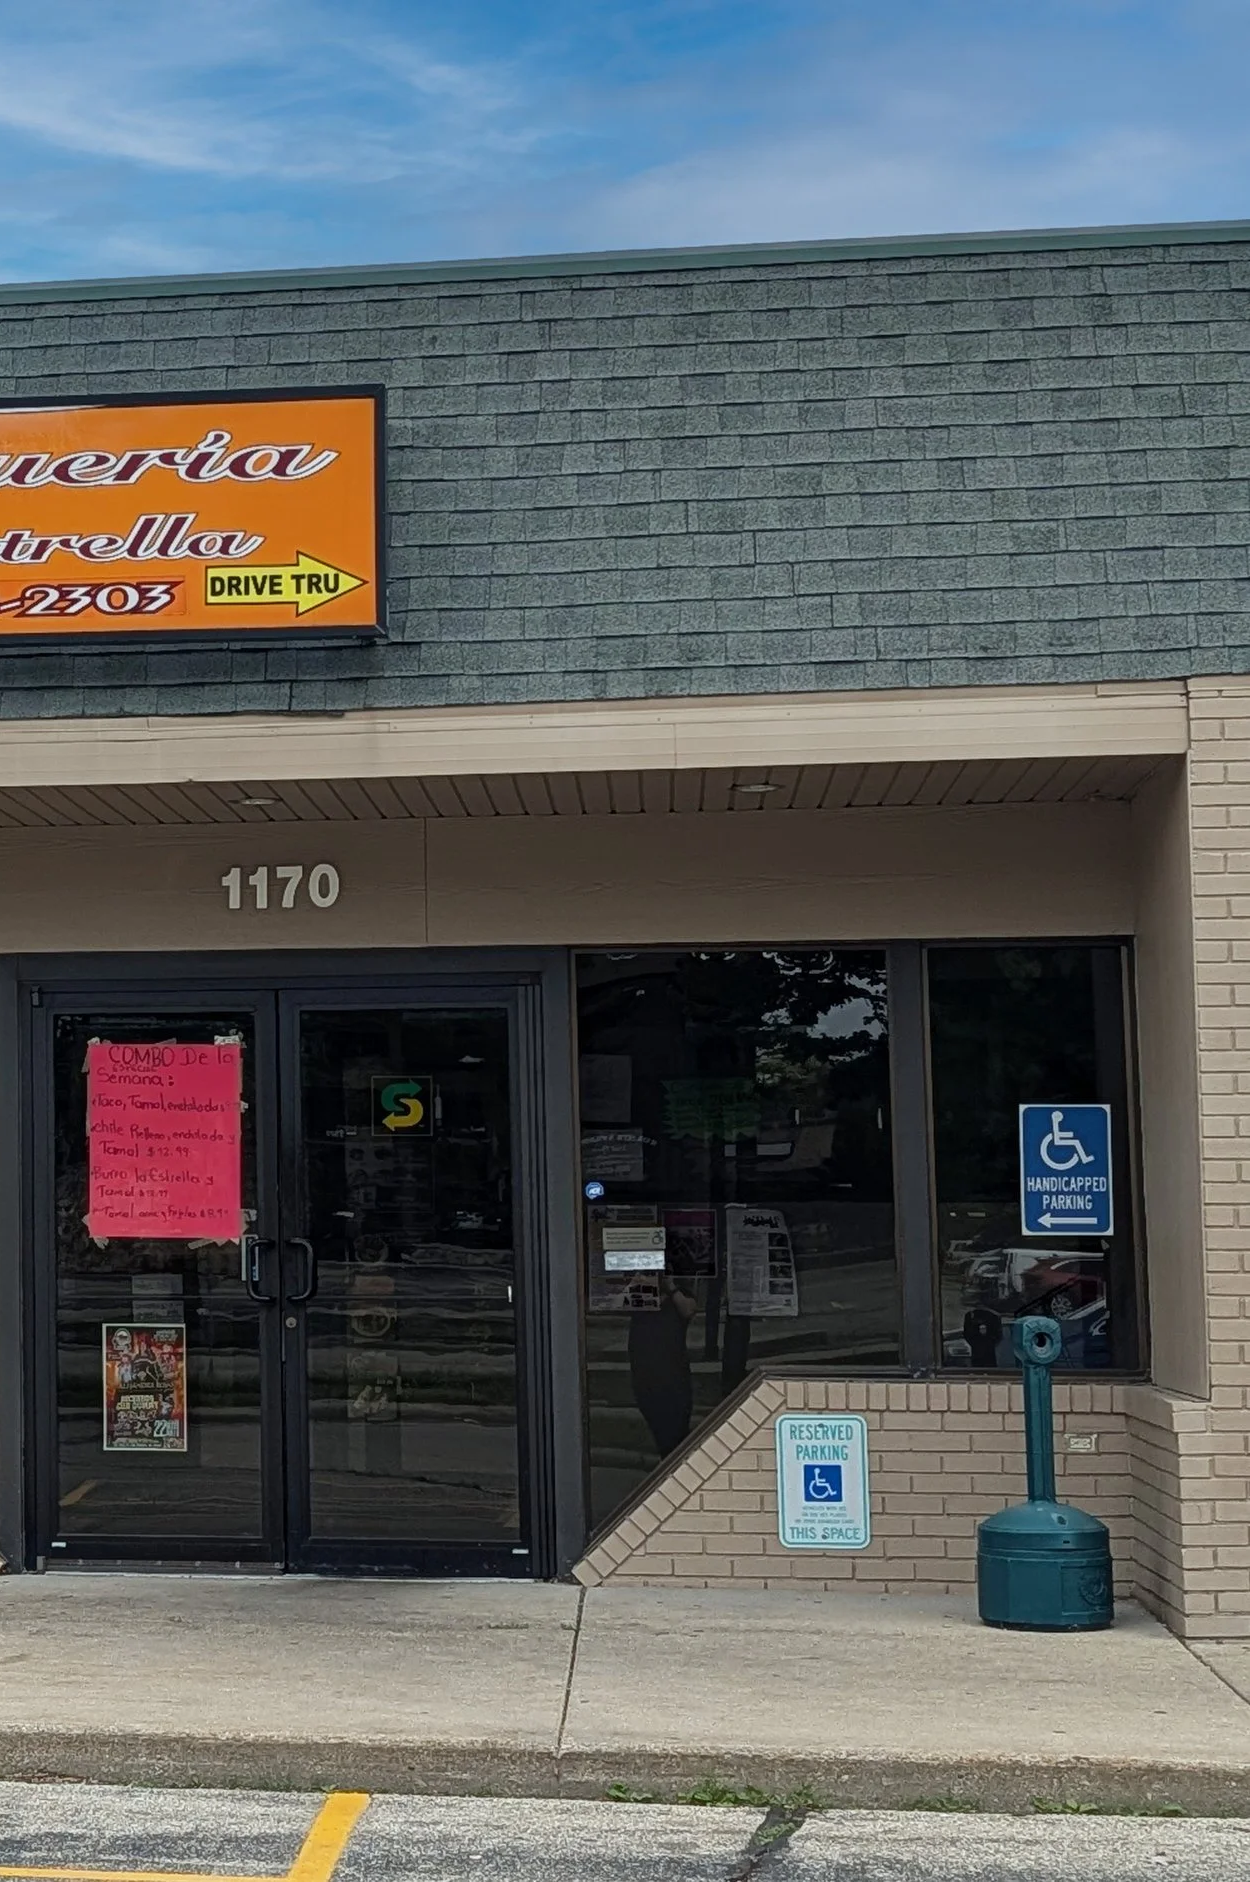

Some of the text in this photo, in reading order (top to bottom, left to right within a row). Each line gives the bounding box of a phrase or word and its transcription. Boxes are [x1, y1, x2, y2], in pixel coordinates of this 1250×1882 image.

[210, 572, 340, 597] DRIVE TRU
[221, 863, 339, 909] 1170
[109, 1046, 175, 1068] COMBO
[180, 1048, 207, 1067] De
[1027, 1177, 1107, 1192] HANDICAPPED
[1043, 1195, 1093, 1210] PARKING
[790, 1424, 853, 1441] RESERVED
[796, 1445, 848, 1461] PARKING
[790, 1526, 861, 1541] THIS SPACE
